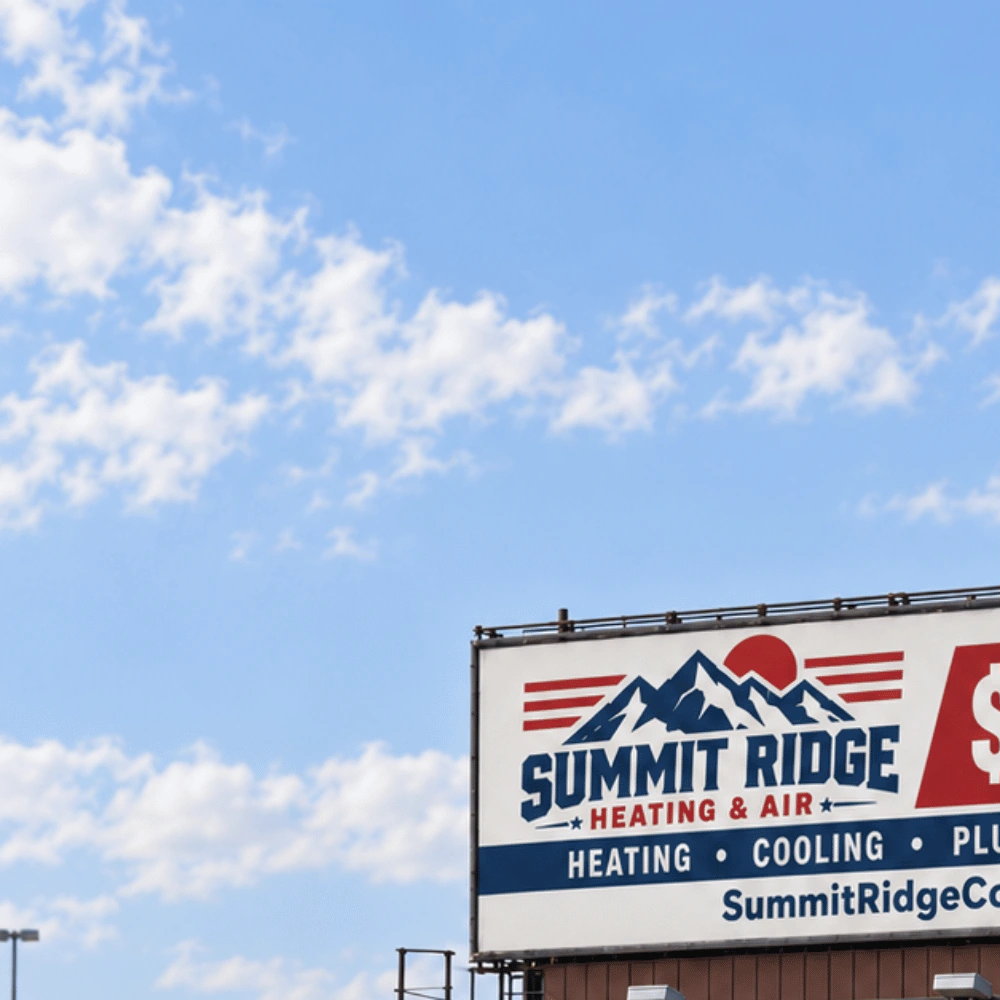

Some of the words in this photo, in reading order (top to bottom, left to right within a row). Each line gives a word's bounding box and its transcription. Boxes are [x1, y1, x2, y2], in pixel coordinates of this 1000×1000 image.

[520, 737, 729, 823] SUMMIT
[744, 724, 900, 794] RIDGE
[590, 798, 716, 830] HEATING
[729, 796, 747, 820] &
[760, 792, 813, 818] AIR
[568, 843, 691, 879] HEATING
[752, 831, 884, 868] COOLING
